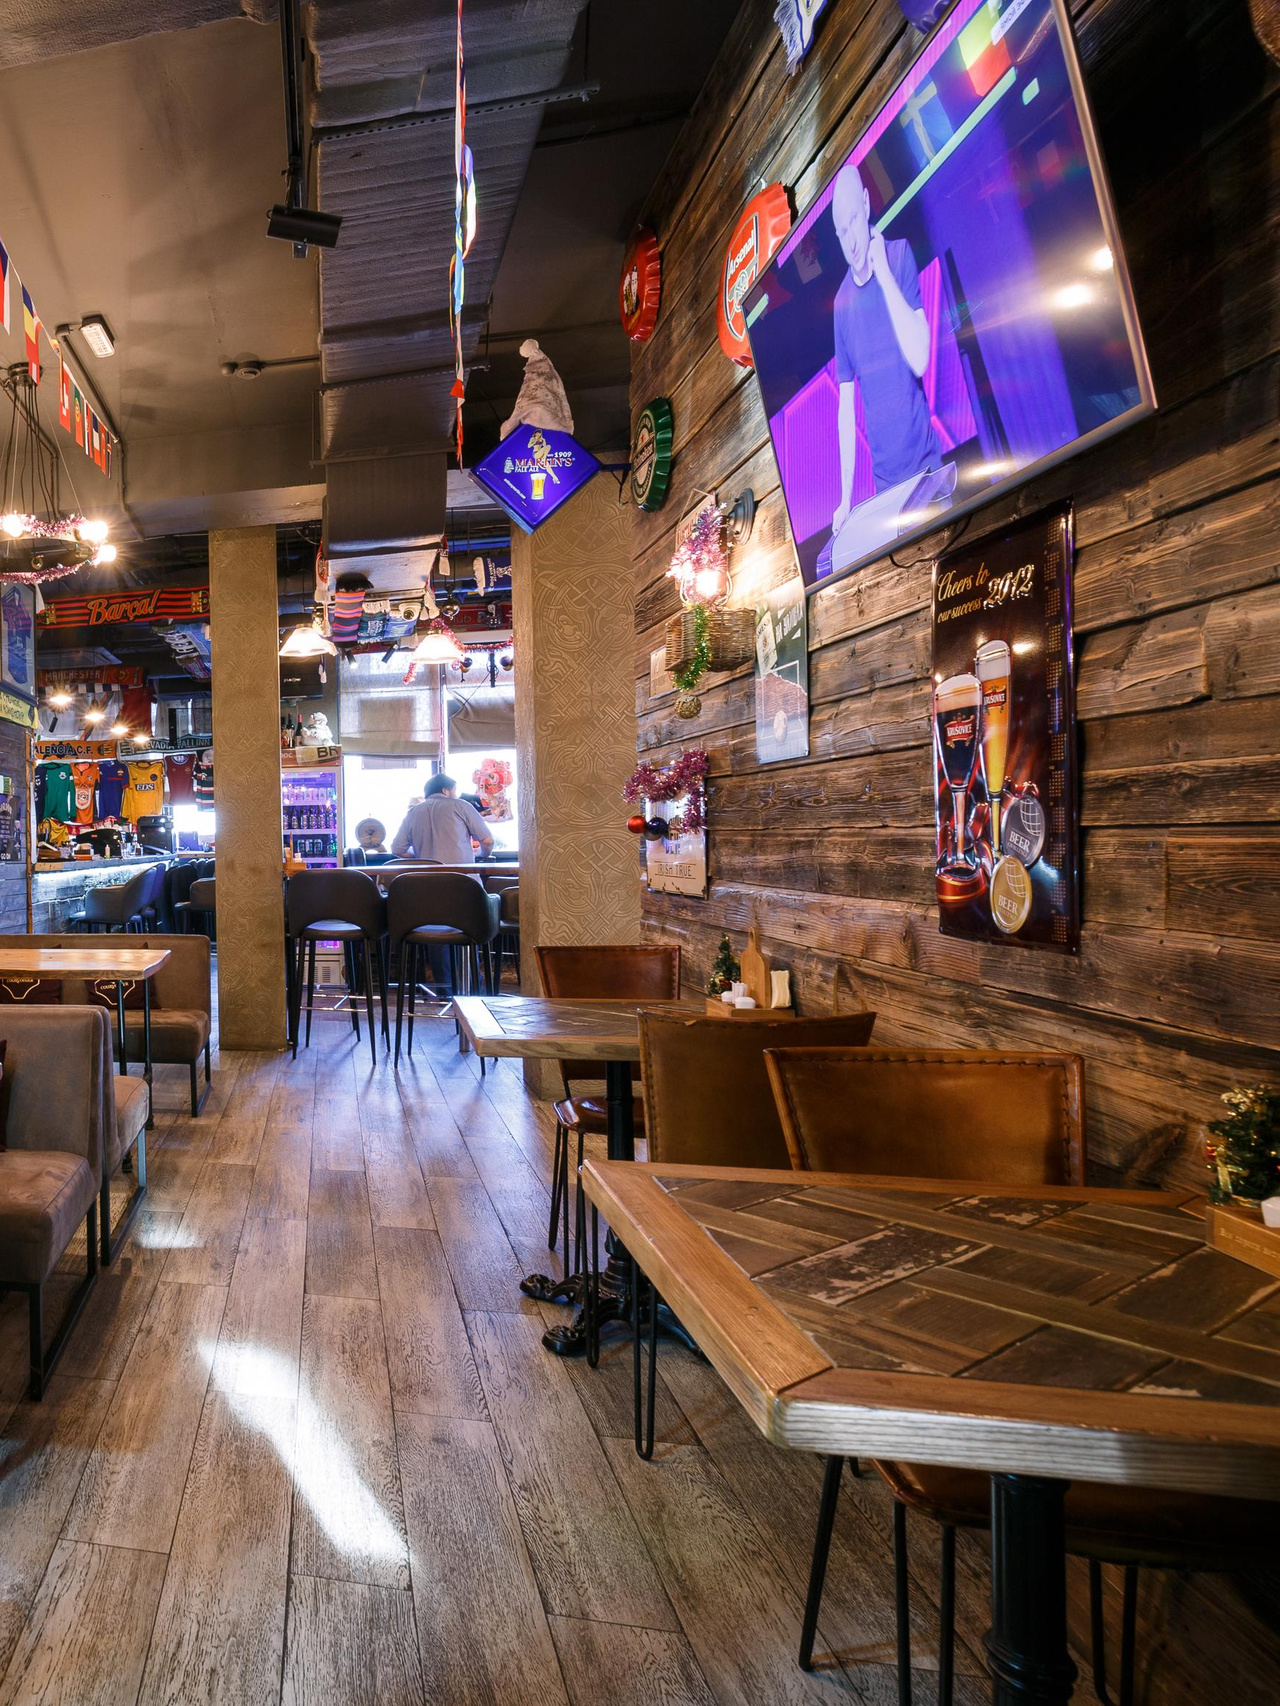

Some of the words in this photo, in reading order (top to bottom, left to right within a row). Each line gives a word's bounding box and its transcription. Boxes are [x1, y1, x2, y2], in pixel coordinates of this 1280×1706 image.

[730, 230, 754, 275] Arsenal
[515, 457, 572, 467] MARTIN'S
[937, 570, 973, 601] Cheers
[975, 562, 990, 587] to
[983, 564, 1035, 609] 2012
[87, 589, 162, 625] Barça!
[937, 611, 952, 623] our
[952, 597, 982, 619] success
[45, 669, 101, 682] MANCHESTER
[35, 744, 75, 756] ALENCIA
[77, 744, 93, 755] C.F.
[136, 783, 154, 791] EDS
[1009, 831, 1031, 853] BEER
[675, 864, 692, 877] TRUE
[998, 894, 1018, 915] BEER
